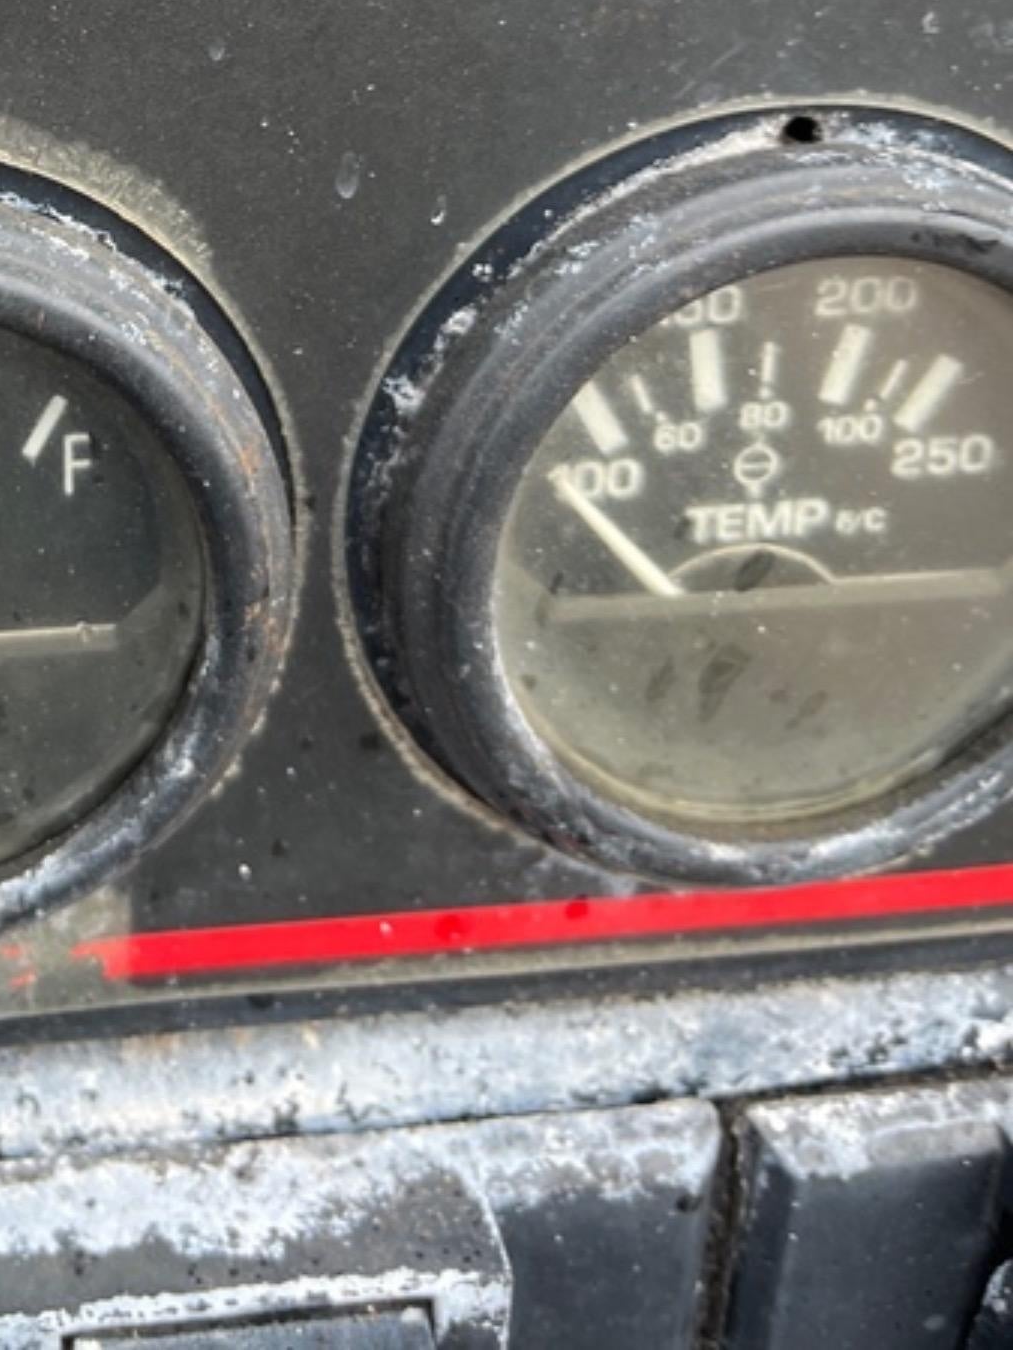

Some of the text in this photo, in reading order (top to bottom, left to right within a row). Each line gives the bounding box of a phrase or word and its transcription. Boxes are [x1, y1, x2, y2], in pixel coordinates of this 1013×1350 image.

[659, 285, 742, 325] 50
[814, 275, 919, 318] 200
[738, 400, 791, 431] 80
[816, 413, 884, 447] 100
[652, 421, 707, 453] 60
[890, 434, 994, 479] 250
[63, 433, 92, 496] F
[685, 497, 830, 544] TEMP
